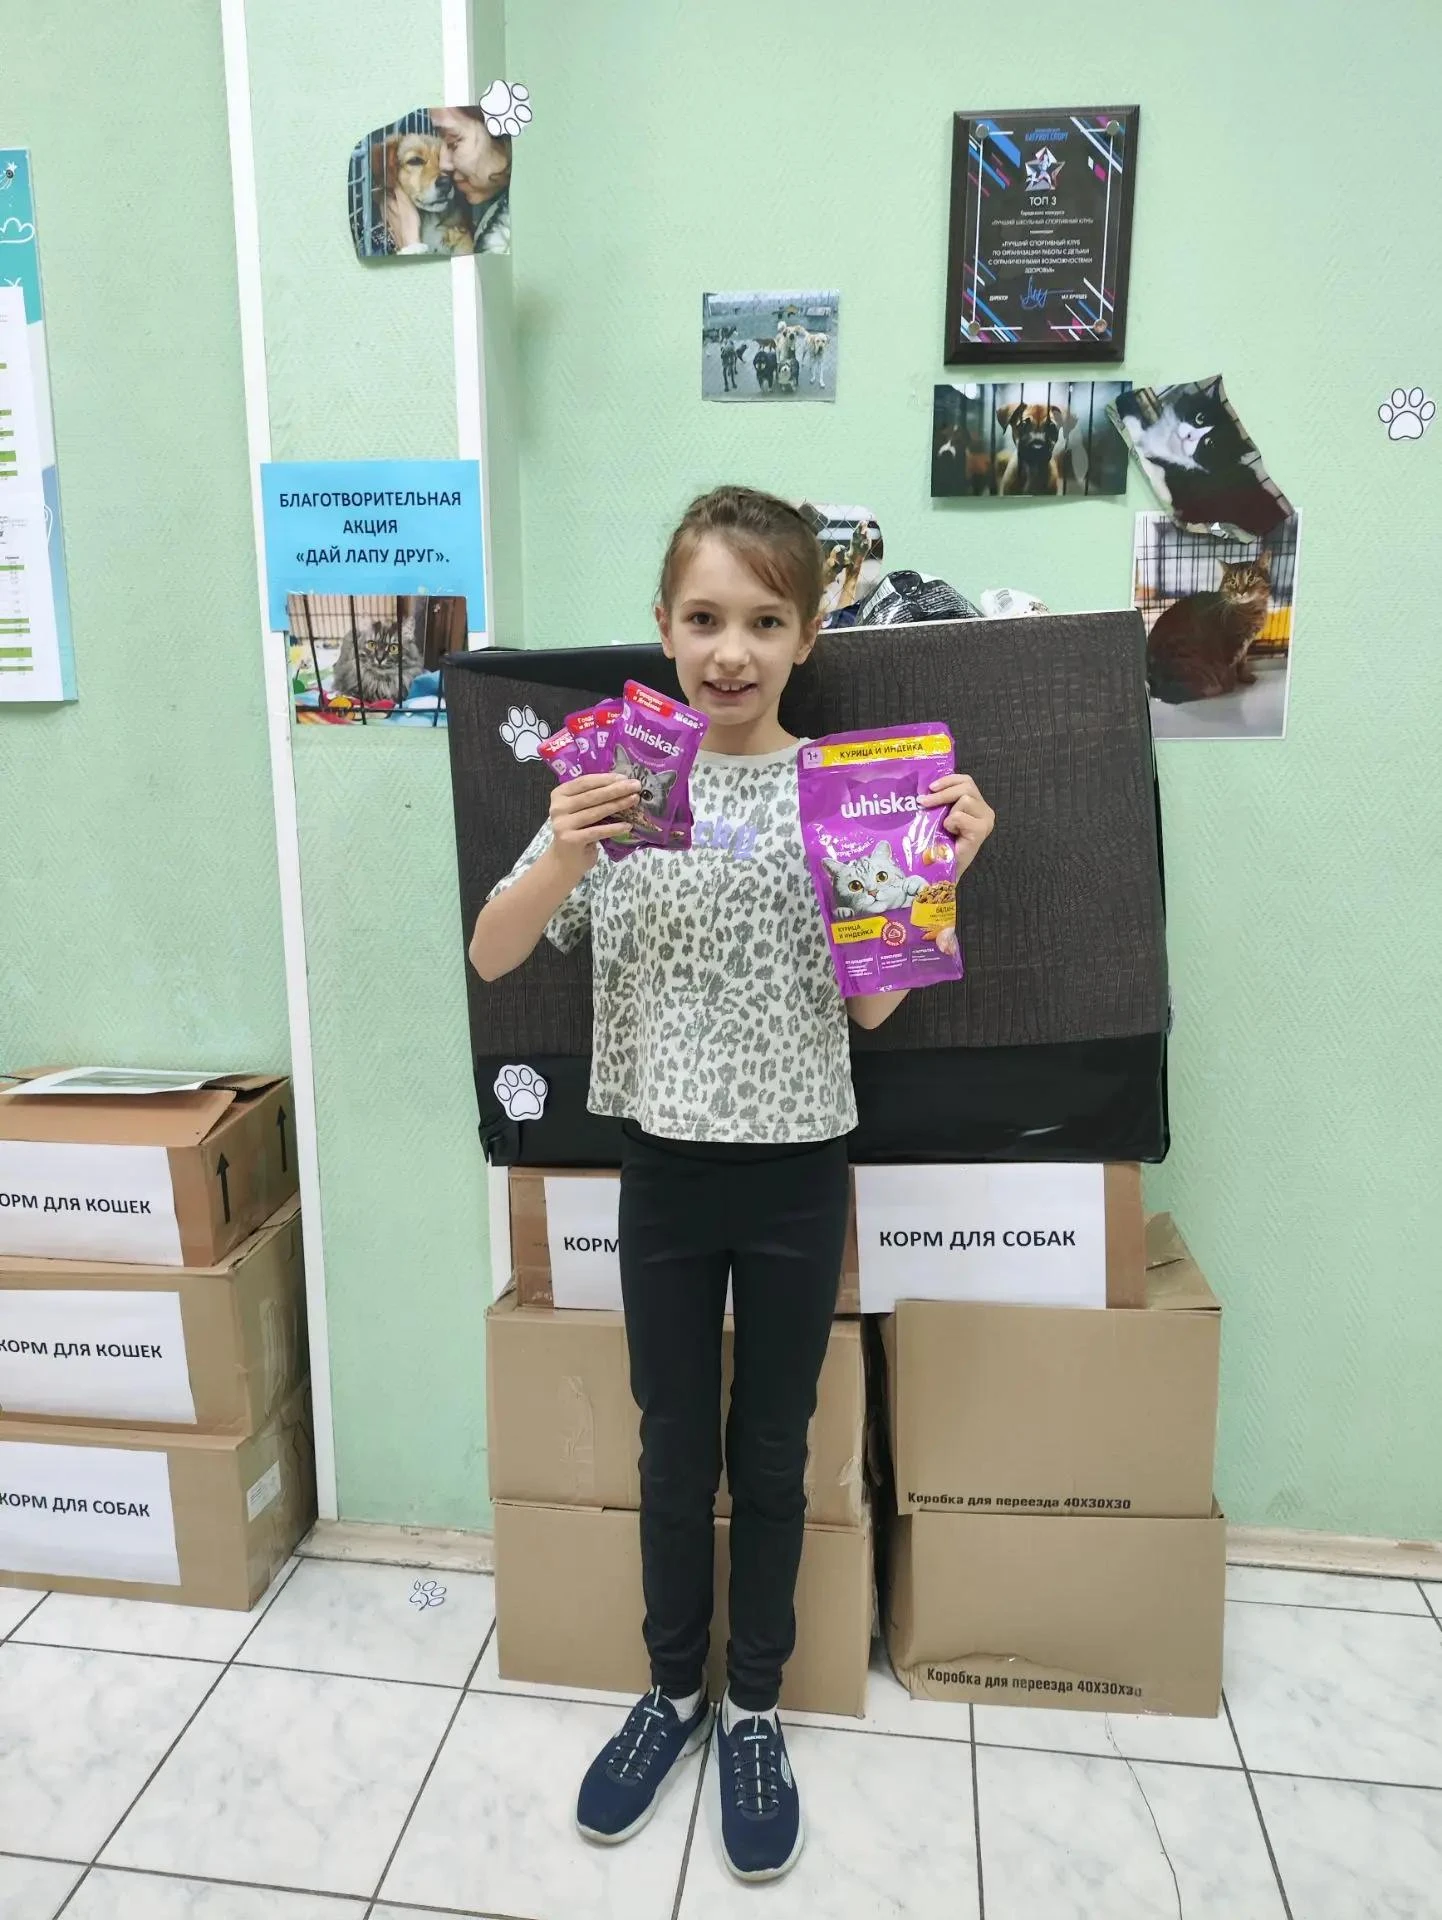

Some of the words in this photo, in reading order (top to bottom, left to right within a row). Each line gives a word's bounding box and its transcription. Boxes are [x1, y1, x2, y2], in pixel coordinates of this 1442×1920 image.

[1030, 196, 1048, 206] ТОП
[1052, 196, 1057, 206] 3
[280, 492, 461, 508] БЛАГОТВОРИТЕЛЬНАЯ
[343, 520, 398, 536] АКЦИЯ
[296, 546, 341, 565] «ДАЙ
[345, 549, 389, 564] ЛАПУ
[394, 549, 450, 566] ДРУГ».
[624, 723, 681, 757] whiskas
[840, 748, 873, 759] КУРИЦА
[838, 924, 861, 933] КУРИЦА
[844, 929, 873, 939] ИНДЕЙКА
[0, 1194, 38, 1209] ОРМ
[44, 1197, 81, 1212] ДЛЯ
[86, 1198, 152, 1214] КОШЕК
[880, 1231, 943, 1247] КОРМ
[950, 1231, 995, 1250] ДЛЯ
[1002, 1230, 1076, 1247] СОБАК
[53, 1343, 91, 1358] ДЛЯ
[96, 1343, 162, 1358] КОШЕК
[0, 1492, 47, 1509] КОРМ
[52, 1497, 88, 1514] ДЛЯ
[92, 1500, 150, 1517] СОБАК
[908, 1492, 963, 1505] Коробка
[968, 1496, 991, 1506] для
[996, 1497, 1059, 1508] переезда
[927, 1668, 980, 1685] Коробка
[985, 1677, 1008, 1688] для
[1012, 1678, 1073, 1692] переезда
